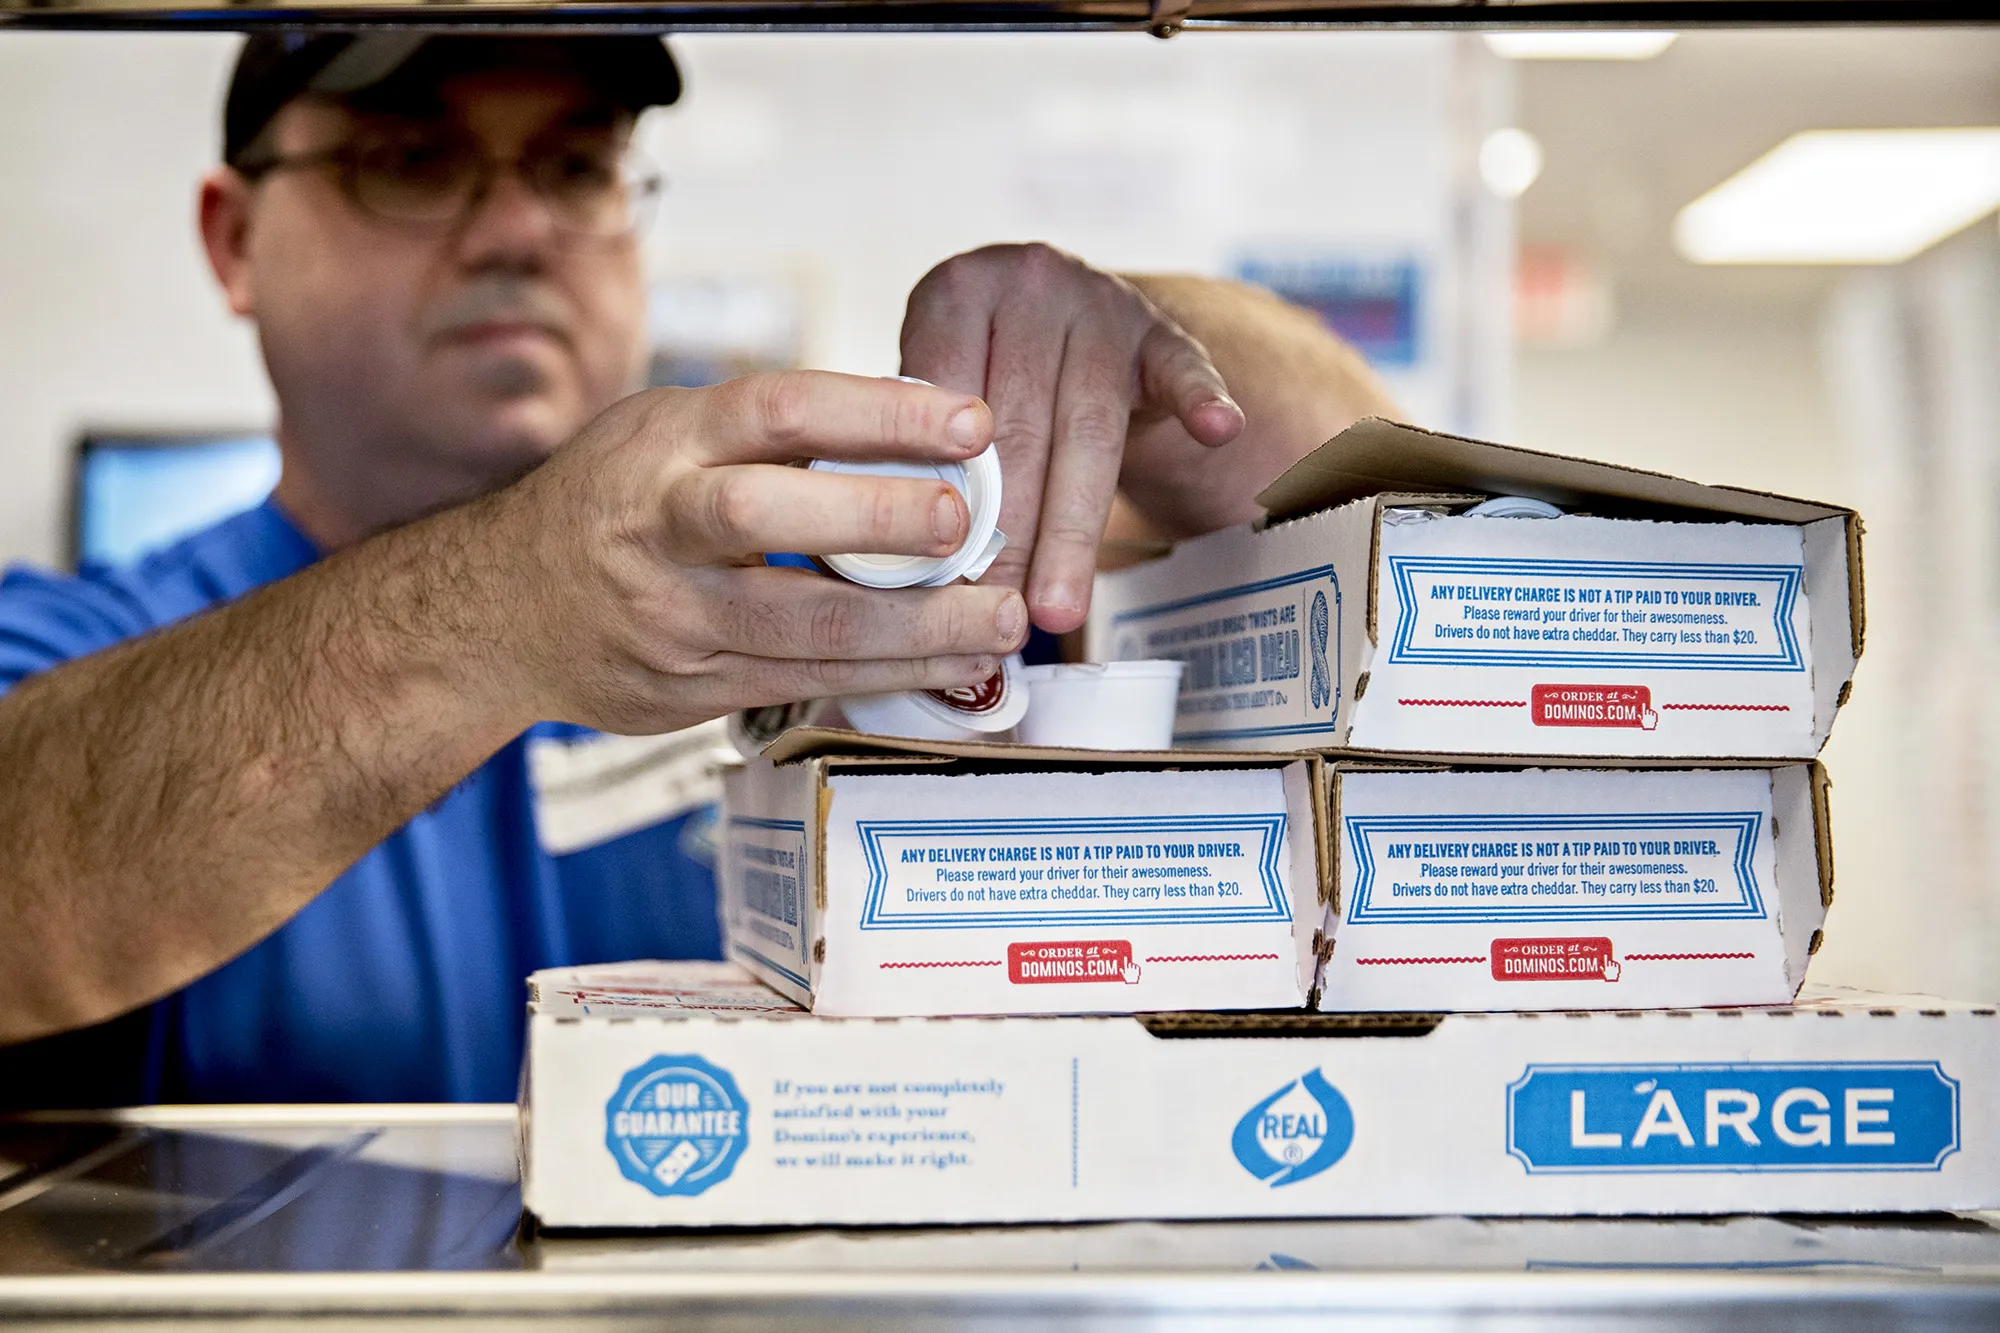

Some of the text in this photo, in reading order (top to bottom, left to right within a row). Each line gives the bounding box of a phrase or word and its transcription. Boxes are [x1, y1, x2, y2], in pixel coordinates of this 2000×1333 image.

[1431, 584, 1761, 607] ANY DELIVERY CHARGE IS NOT A TIP PAID TO YOUR DRIVER.
[1248, 608, 1277, 629] TWISTS
[1280, 604, 1296, 624] ARE
[1463, 605, 1728, 625] Please reward your driver for their awesomeness.
[1435, 623, 1757, 646] Drivers do not have extra cheddar. They carry less than $20.
[1260, 629, 1300, 682] BREAD
[1561, 691, 1619, 701] ORDER at
[1544, 704, 1636, 720] DOMINOS.COM
[901, 842, 1244, 863] ANY DELIVERY CHARGE IS NOT A TIP PAID TO YOUR DRIVER.
[1388, 839, 1720, 859] ANY DELIVERY CHARGE IS NOT A TIP PAID TO YOUR DRIVER.
[937, 865, 1212, 884] Please reward your driver for their awesomeness.
[1421, 861, 1687, 879] Please reward your driver for their awesomeness.
[906, 881, 1242, 902] Drivers do not have extra cheddar. They carry less than $20.
[1393, 878, 1718, 897] Drivers do not have extra cheddar. They carry less than $20.
[1038, 946, 1100, 958] ORDER at
[1522, 944, 1580, 955] ORDER at
[1021, 960, 1118, 977] DOMINOS.COM
[1505, 958, 1598, 973] DOMINOS.COM
[655, 1082, 700, 1109] OUR
[774, 1078, 1005, 1101] If you are not completely
[773, 1104, 949, 1122] satisfied with your
[1570, 1087, 1895, 1147] LARGE
[614, 1110, 741, 1137] GUARANTEE
[1263, 1113, 1324, 1139] REAL
[774, 1127, 976, 1147] Domino's experience,
[775, 1151, 974, 1170] we will make it right.
